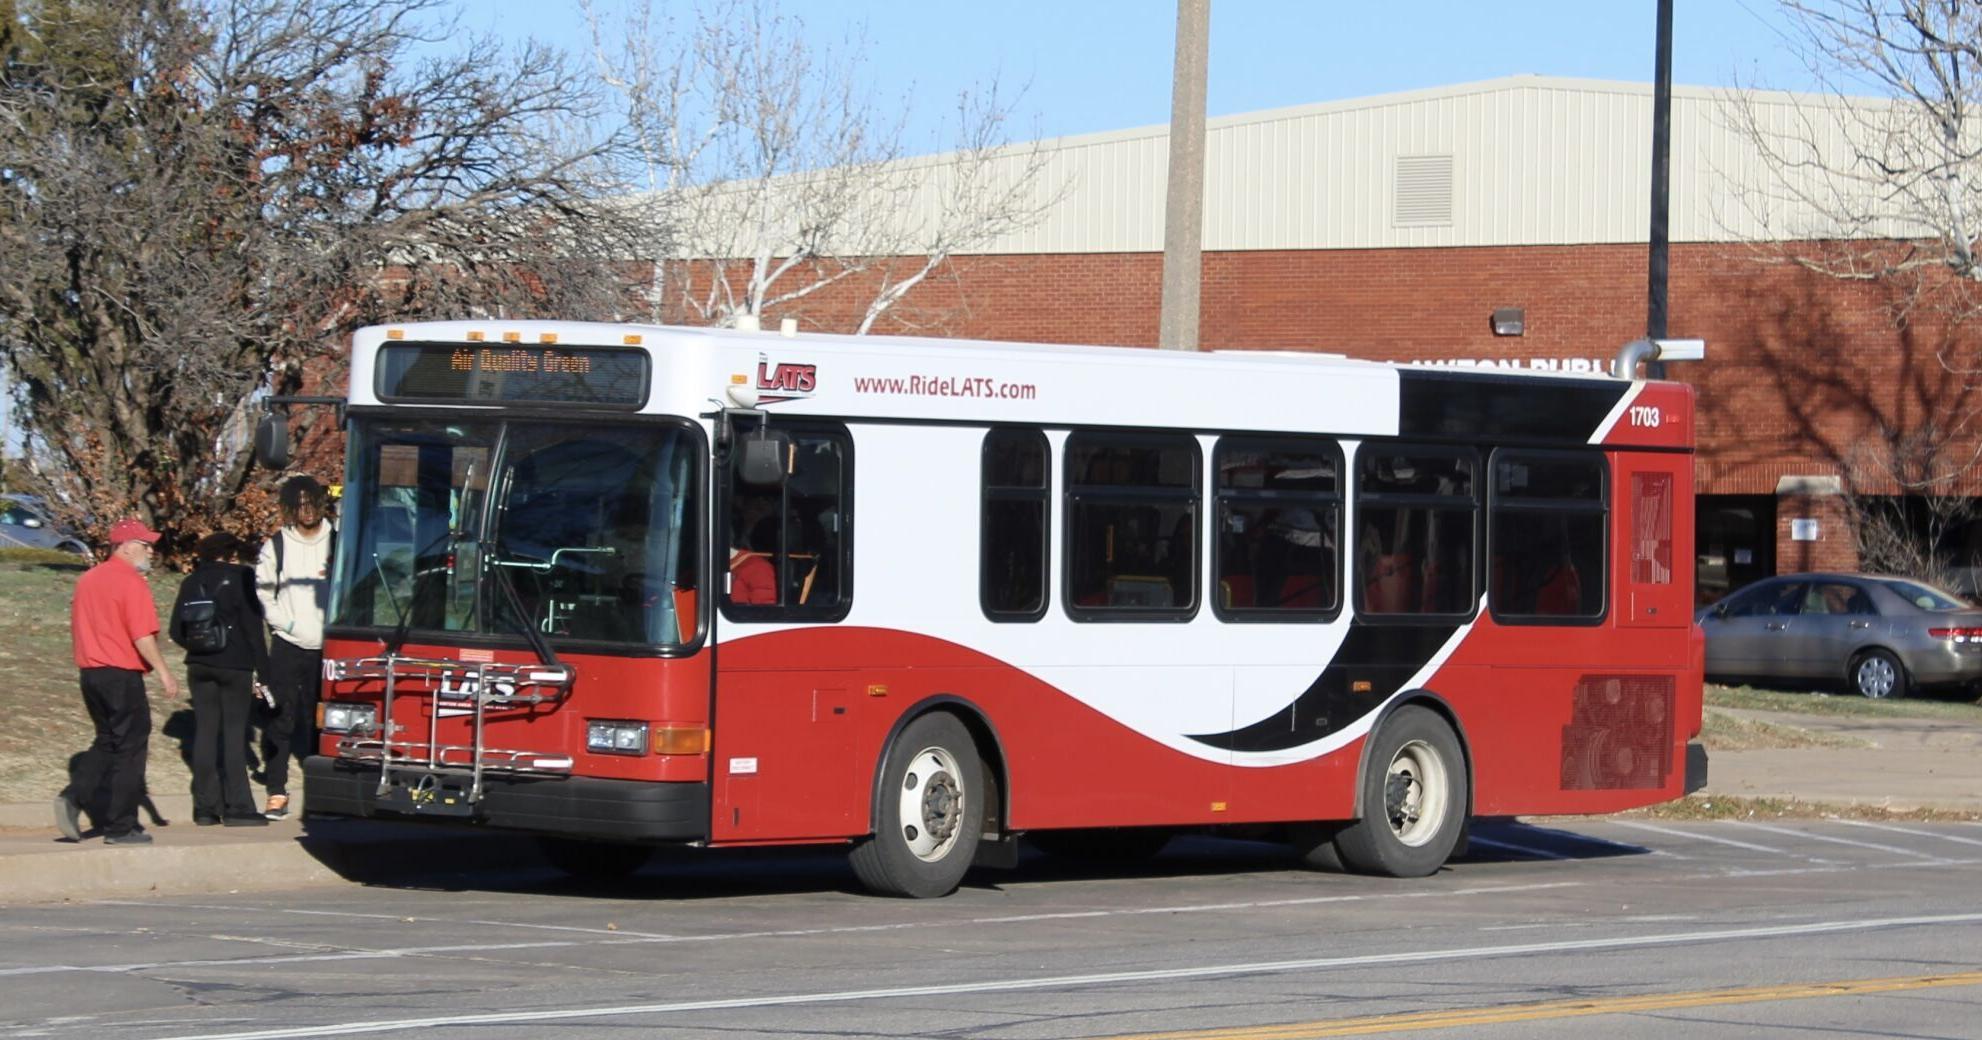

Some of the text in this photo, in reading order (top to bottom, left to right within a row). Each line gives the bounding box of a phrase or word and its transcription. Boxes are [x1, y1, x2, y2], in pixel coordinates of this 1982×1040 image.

[451, 348, 591, 373] Air Quality Green
[757, 362, 817, 392] LATS
[854, 375, 1036, 399] www.RideLATS.com
[1629, 406, 1660, 427] 1703
